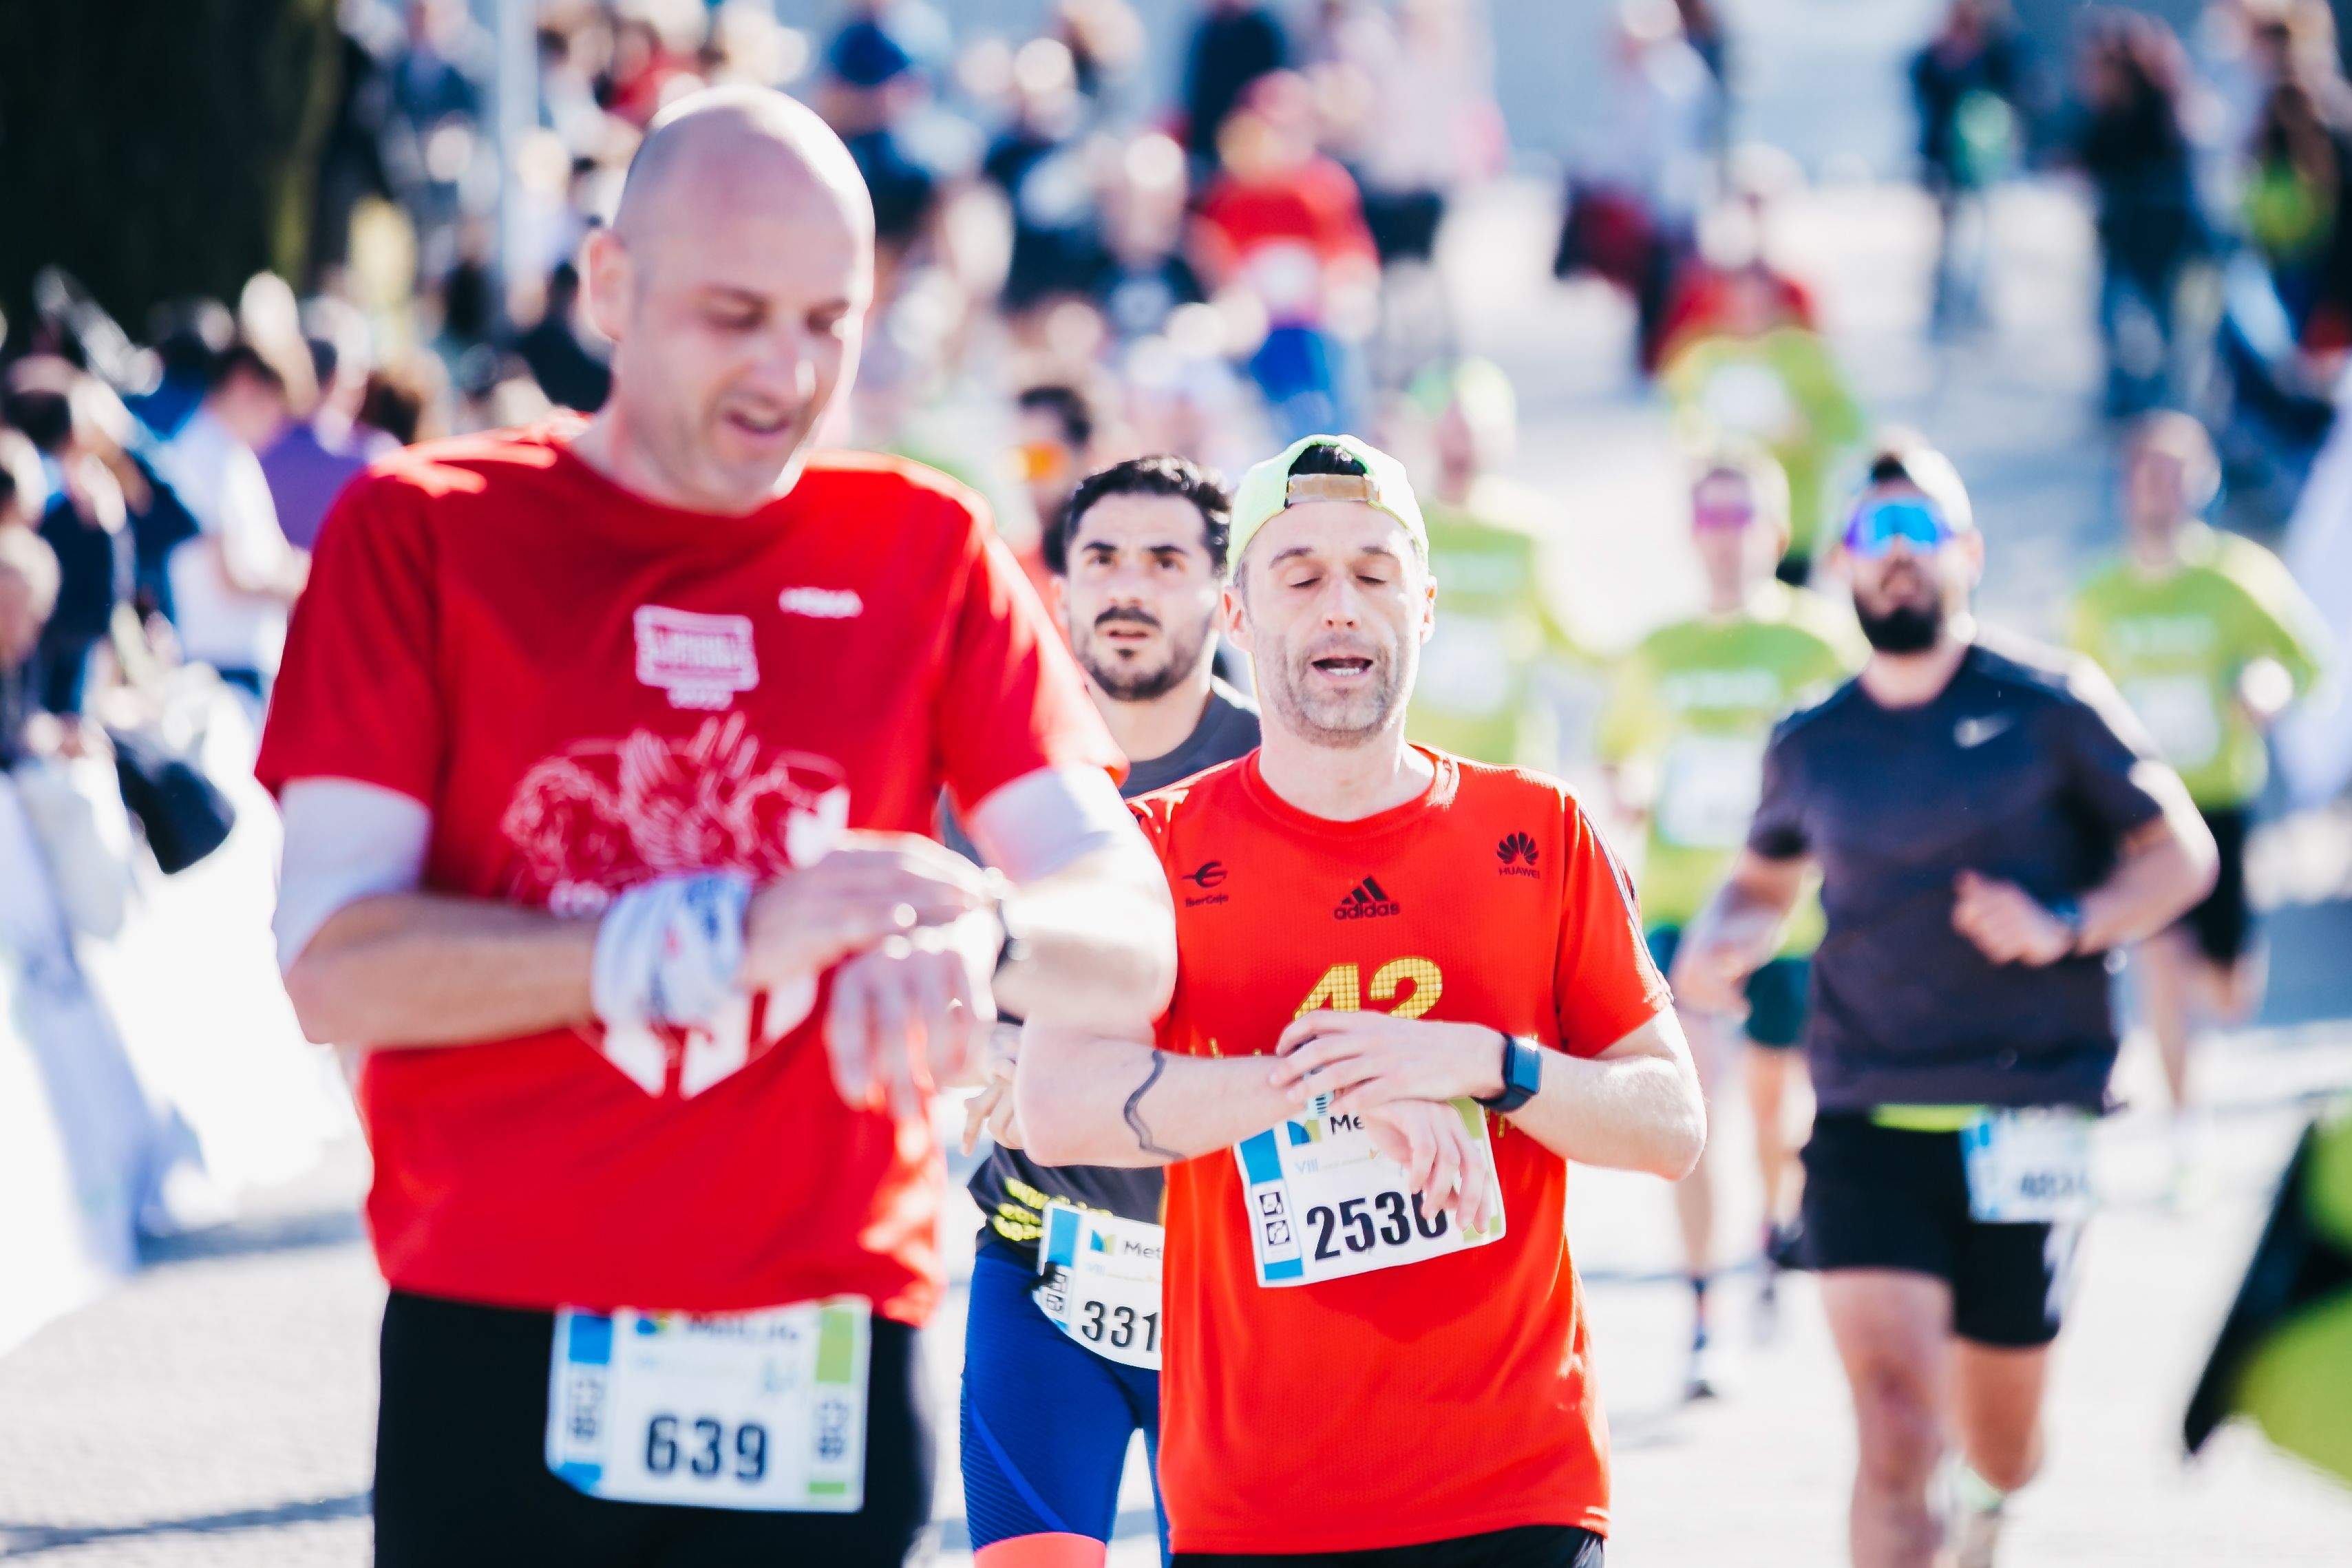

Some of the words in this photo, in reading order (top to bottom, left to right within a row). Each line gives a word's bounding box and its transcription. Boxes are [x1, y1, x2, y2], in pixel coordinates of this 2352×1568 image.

[1498, 866, 1540, 880] HUAWEI
[1333, 902, 1400, 920] adidas
[1293, 957, 1443, 1023] 42
[1081, 1300, 1160, 1352] 331
[644, 1413, 767, 1483] 639
